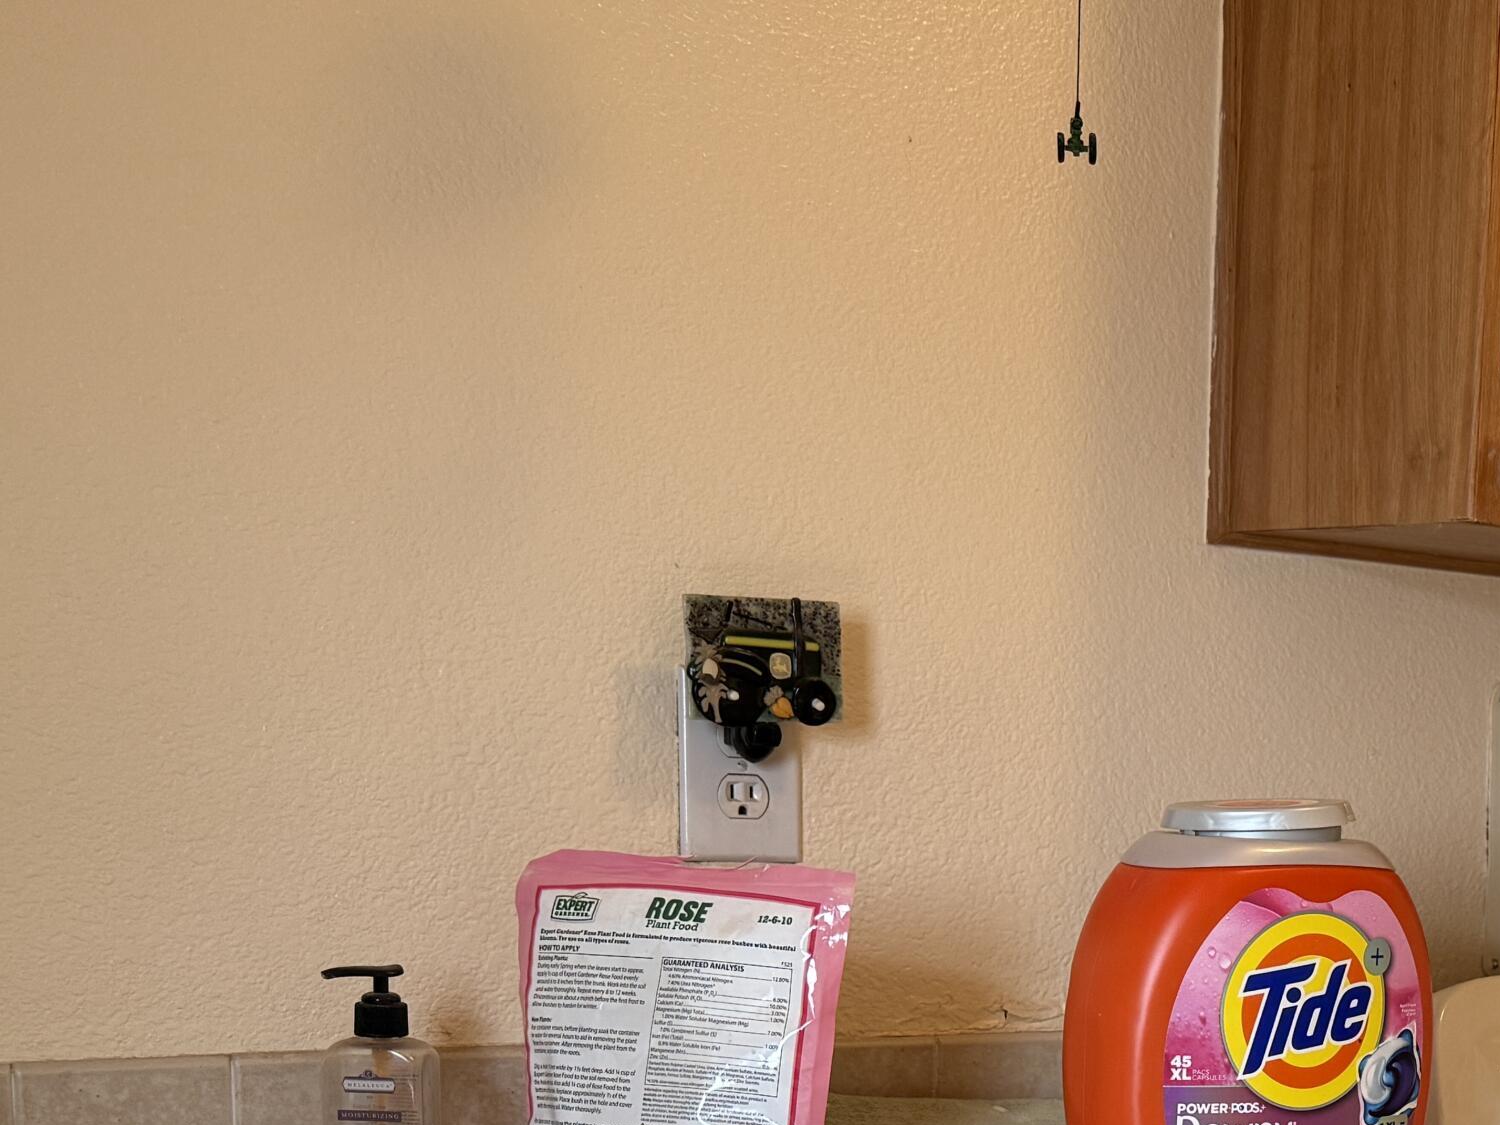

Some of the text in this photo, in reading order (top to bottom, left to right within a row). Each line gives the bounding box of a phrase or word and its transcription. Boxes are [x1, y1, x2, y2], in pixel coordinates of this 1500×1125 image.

[556, 899, 595, 912] EXPERT
[646, 897, 714, 924] ROSE
[646, 920, 699, 932] Plant Food
[758, 915, 793, 926] 12-6-10
[592, 937, 607, 945] types
[632, 932, 662, 940] formulated
[669, 935, 692, 943] produce
[693, 937, 717, 945] vigorous
[754, 941, 768, 949] with
[768, 943, 796, 952] beautiful
[663, 958, 745, 972] GUARANTEED ANALYSIS
[1238, 959, 1374, 1080] Tide
[1170, 1055, 1192, 1068] 45
[1170, 1068, 1192, 1080] XL
[1177, 1103, 1228, 1114] POWER
[341, 1112, 399, 1120] MOISTURIZING
